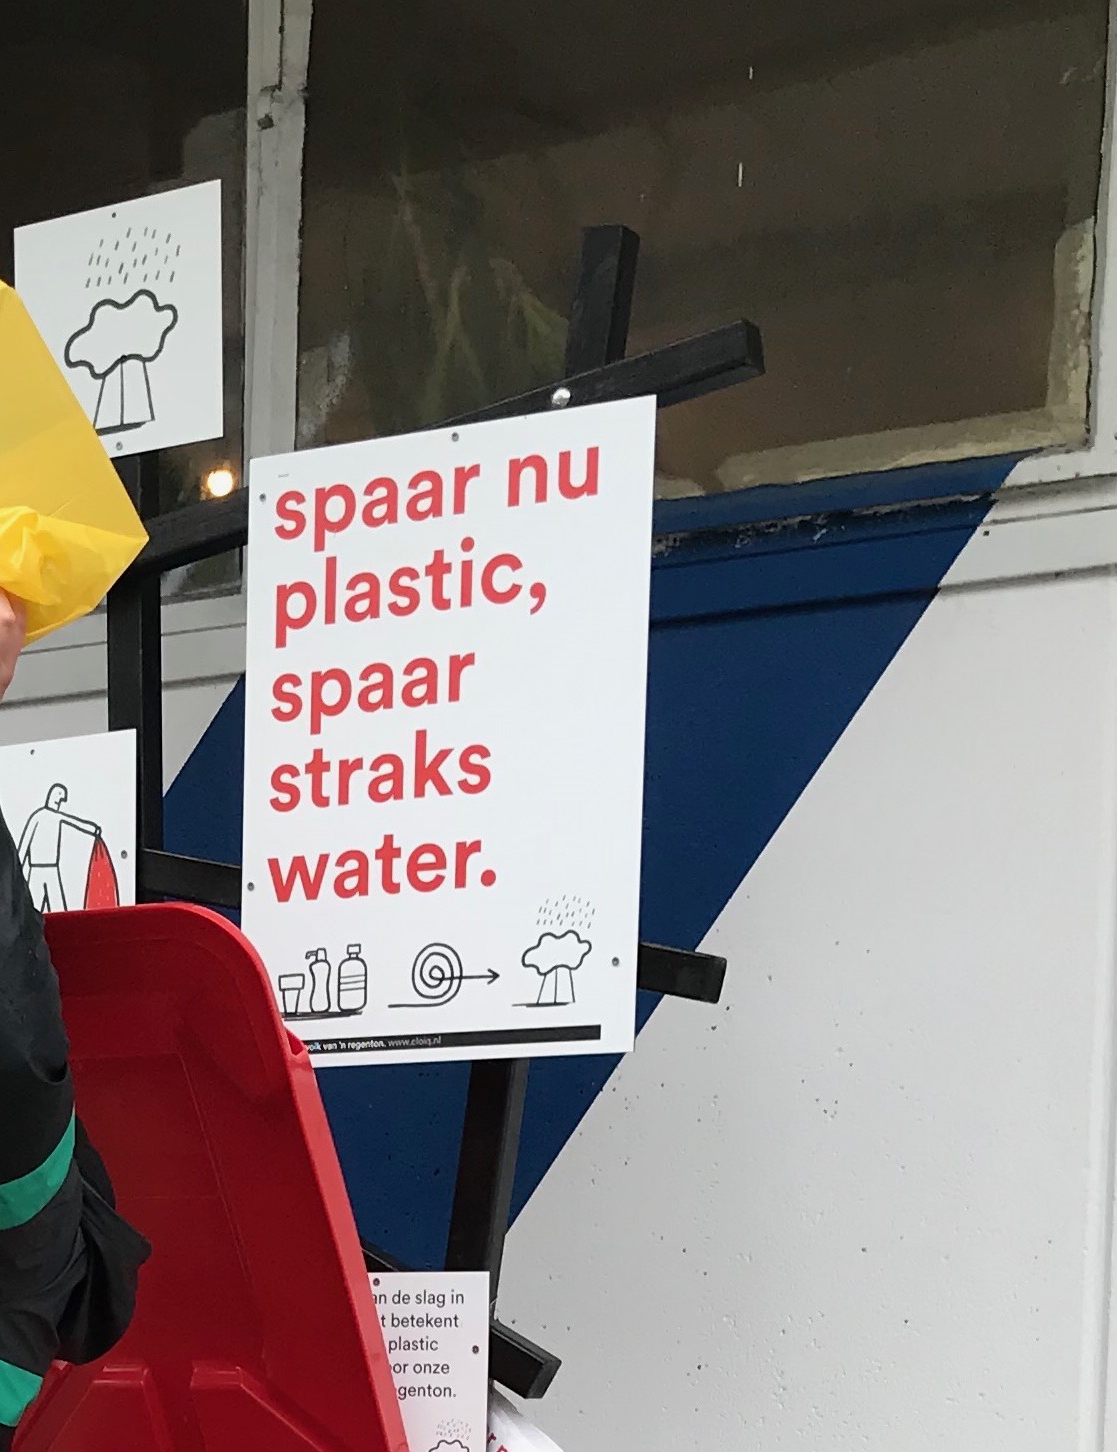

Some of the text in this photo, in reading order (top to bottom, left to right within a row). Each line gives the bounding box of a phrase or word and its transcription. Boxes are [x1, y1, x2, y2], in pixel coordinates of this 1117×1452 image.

[275, 447, 599, 552] spaar nu
[275, 536, 547, 648] plastic,
[271, 653, 475, 735] spaar
[269, 729, 492, 813] straks
[267, 834, 497, 903] water.
[323, 1042, 337, 1050] van
[347, 1039, 386, 1050] regenton.
[391, 1313, 459, 1327] betekent
[392, 1290, 411, 1305] de
[415, 1289, 445, 1308] slag
[451, 1289, 464, 1304] in
[388, 1336, 439, 1354] plastic
[390, 1362, 450, 1374] or onze
